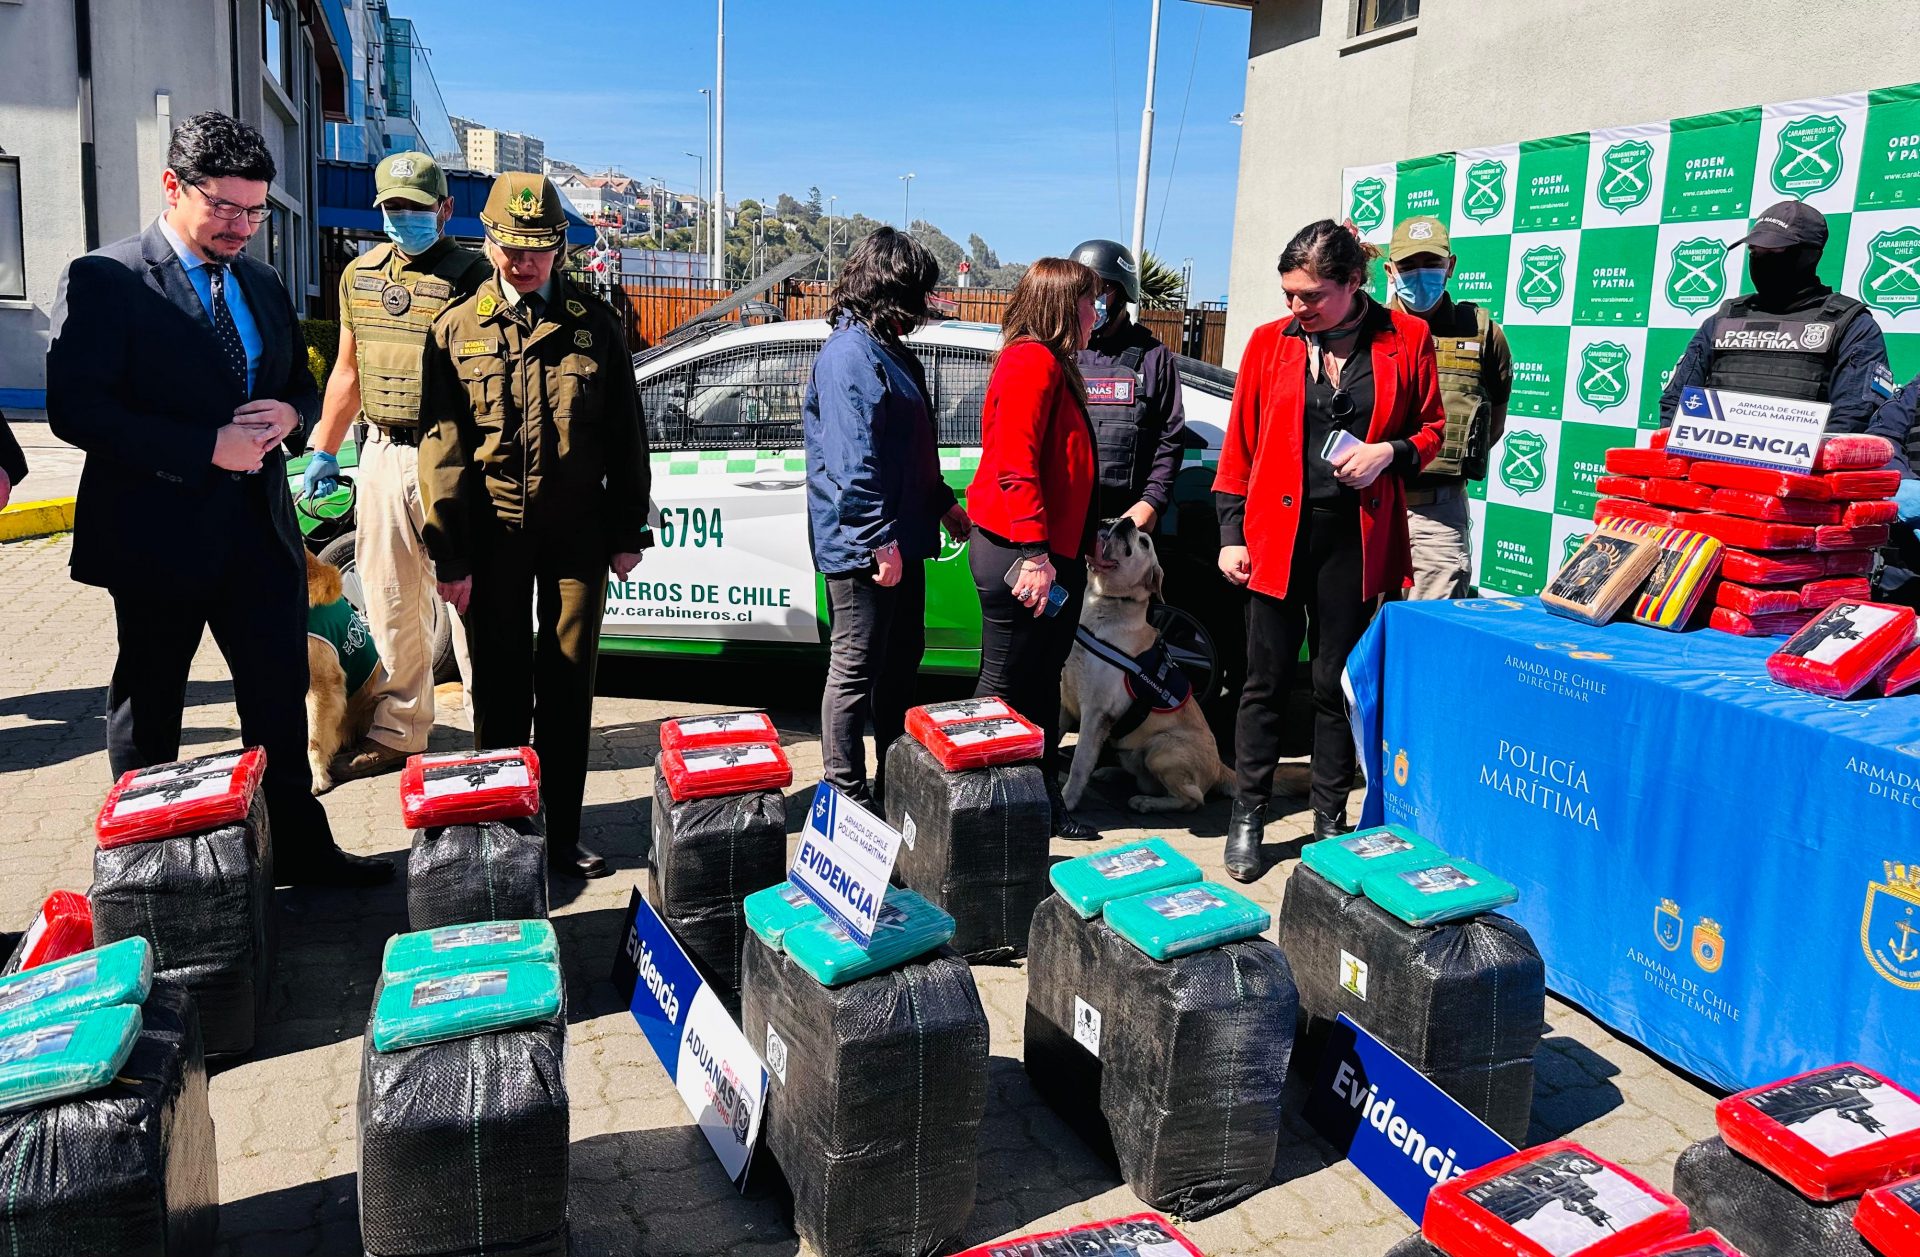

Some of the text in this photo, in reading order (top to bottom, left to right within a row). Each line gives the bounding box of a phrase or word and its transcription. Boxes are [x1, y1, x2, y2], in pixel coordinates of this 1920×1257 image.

[1787, 126, 1826, 138] CARABINEROS
[1685, 156, 1725, 169] ORDEN
[1888, 151, 1893, 162] Y
[1532, 174, 1562, 186] ORDEN
[1685, 168, 1734, 181] Y PATRIA
[1408, 190, 1433, 200] ORDEN
[1531, 184, 1570, 197] Y PATRIA
[1414, 198, 1440, 208] PATRIA
[1459, 272, 1486, 280] ORDEN
[1593, 268, 1626, 277] ORDEN
[1465, 282, 1492, 290] PATRIA
[1592, 279, 1634, 288] Y PATRIA
[1725, 330, 1792, 340] POLICIA
[1715, 338, 1799, 350] MARITIMA
[1514, 362, 1543, 372] ORDEN
[1513, 372, 1550, 382] Y PATRIA
[1730, 408, 1819, 425] POLICIA MARITIMA
[1738, 402, 1816, 416] ARMADA DE CHILE
[1675, 424, 1811, 458] EVIDENCIA
[1574, 461, 1606, 473] ORDEN
[1573, 472, 1603, 483] Y PAT
[660, 508, 723, 548] 6794
[1497, 540, 1526, 552] ORDEN
[1496, 550, 1534, 566] Y PATRIA
[691, 584, 719, 604] DE
[728, 586, 791, 607] CHILE
[1504, 654, 1607, 695] ARMADA DE CHILE
[1140, 673, 1163, 694] ADUANAS
[1518, 673, 1589, 702] DIRECTEMAR
[1498, 739, 1590, 794] POLICÍA
[1845, 756, 1920, 792] ARMADA
[1480, 764, 1600, 831] MARÍTIMA
[1399, 799, 1420, 817] CHILE
[845, 815, 888, 851] ARMADA DE CHILE
[838, 822, 890, 865] POLICIA MARITIMA
[800, 840, 874, 920] EVIDENCIA
[626, 924, 679, 1026] Evidencia
[1626, 947, 1740, 1022] ARMADA DE CHILE
[1644, 970, 1720, 1024] DIRECTEMAR
[686, 1028, 735, 1108] ADUANAS
[722, 1060, 739, 1087] CHILE
[704, 1081, 730, 1126] CUSTOMS
